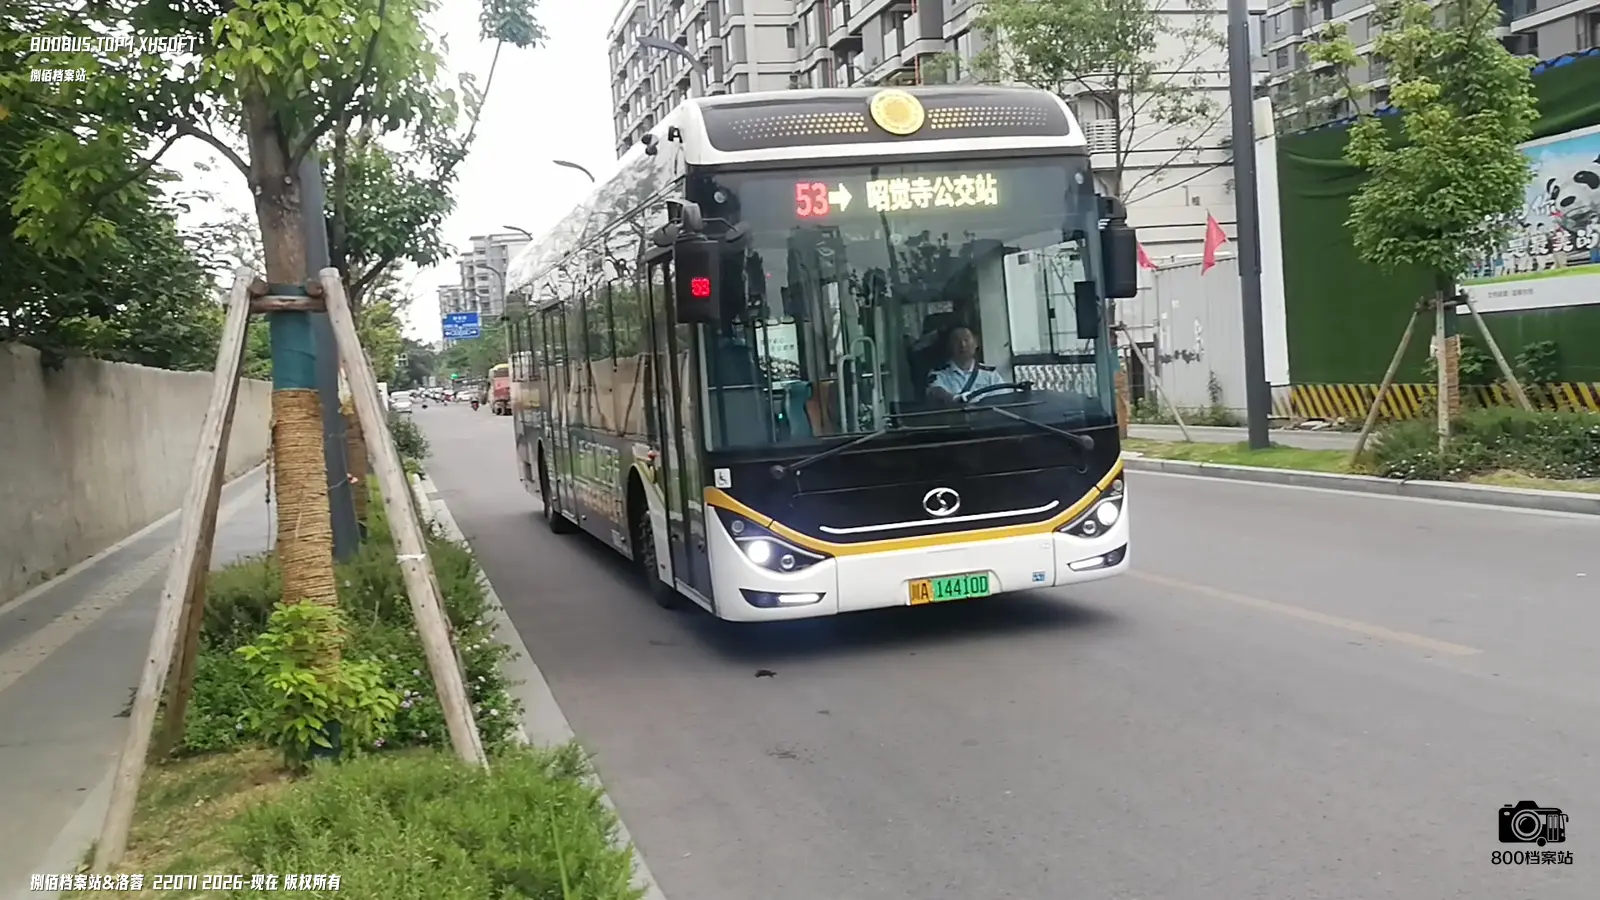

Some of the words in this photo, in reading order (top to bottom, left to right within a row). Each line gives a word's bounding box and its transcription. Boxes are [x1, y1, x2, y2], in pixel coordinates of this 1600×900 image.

[795, 182, 830, 217] 53
[865, 173, 998, 212] 昭觉寺公交站
